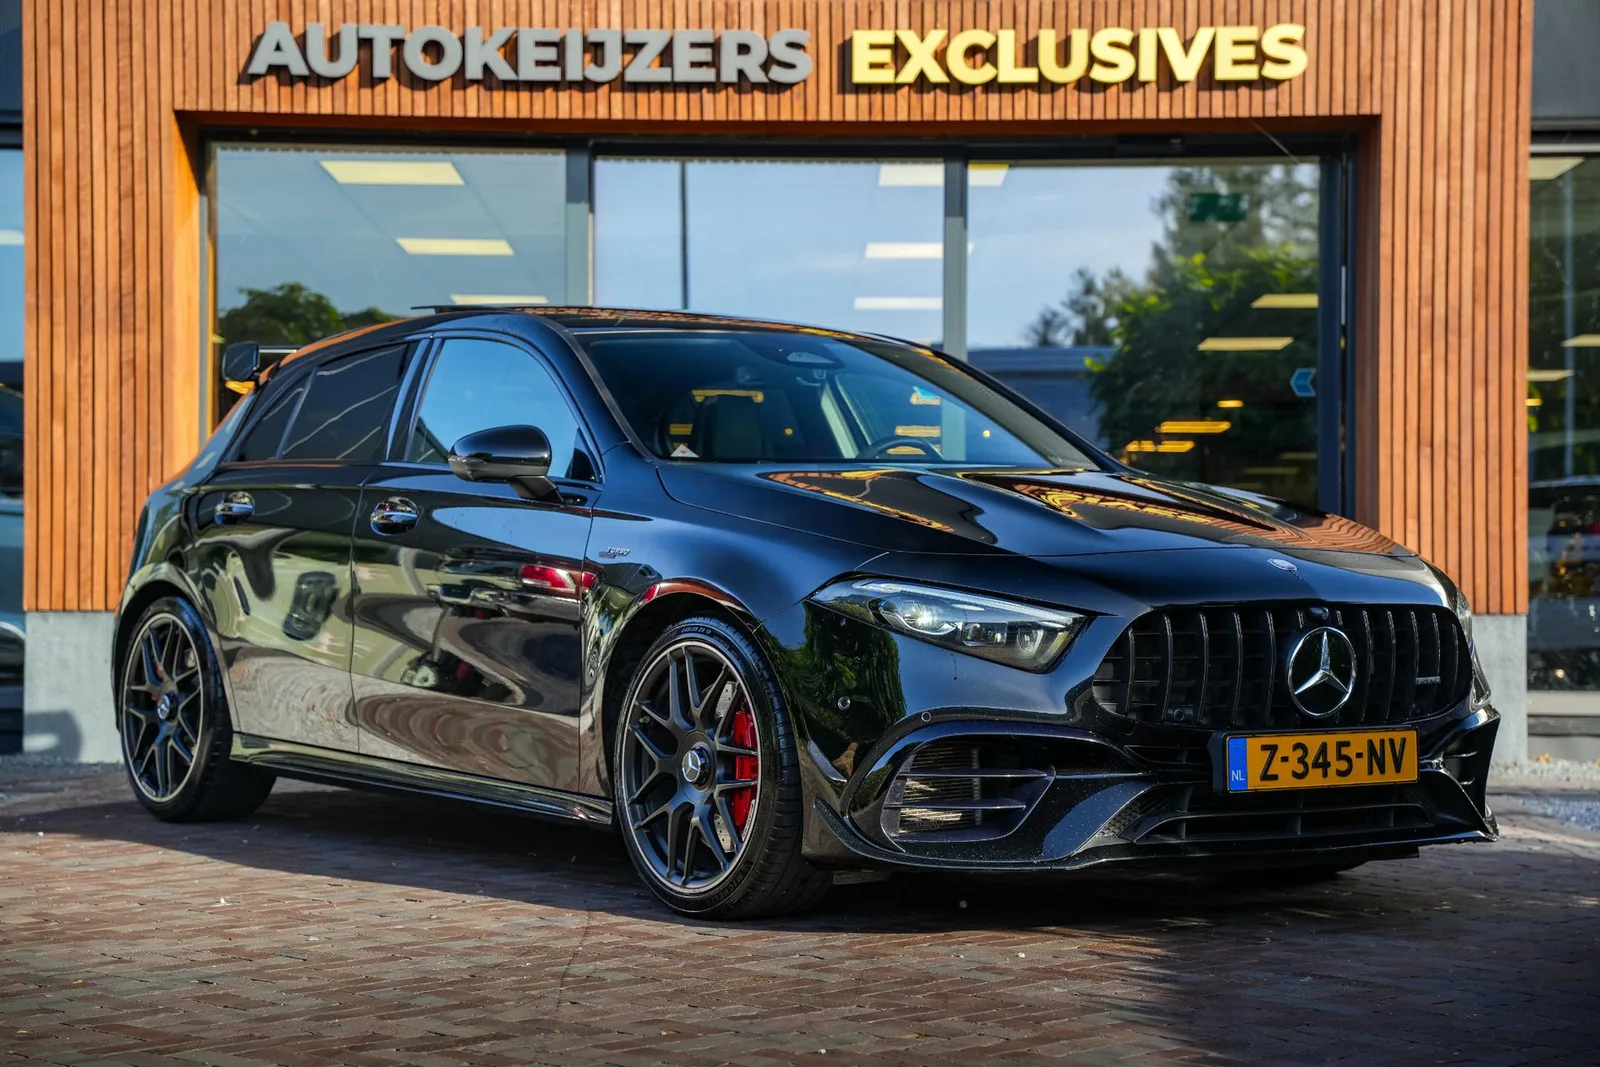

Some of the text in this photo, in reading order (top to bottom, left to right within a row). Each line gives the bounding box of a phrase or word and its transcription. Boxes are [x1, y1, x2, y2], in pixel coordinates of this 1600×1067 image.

[247, 21, 1309, 85] AUTOKEIJZERS EXCLUSIVES
[1231, 769, 1246, 781] NL
[1259, 737, 1407, 782] Z-345-NV
